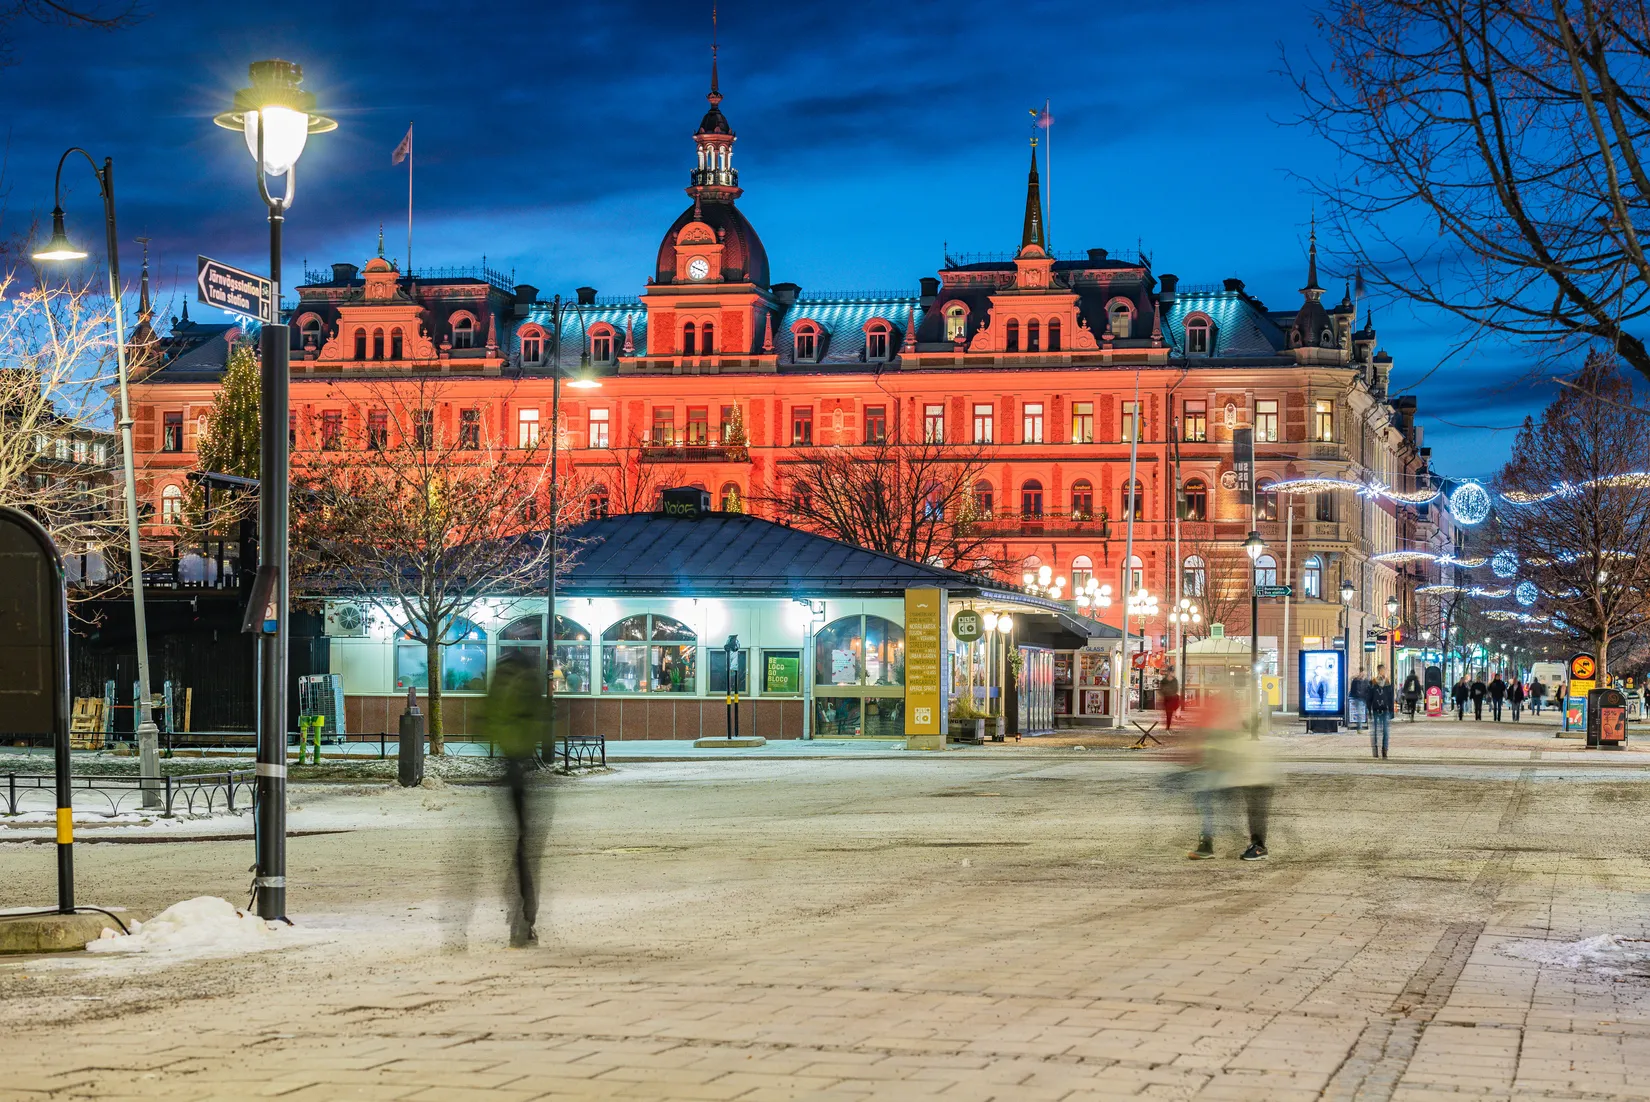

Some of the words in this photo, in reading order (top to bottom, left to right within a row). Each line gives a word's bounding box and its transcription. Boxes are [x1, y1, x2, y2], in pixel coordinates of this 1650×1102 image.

[209, 269, 259, 297] Järnvägsstation
[209, 284, 227, 302] Train
[227, 292, 250, 309] station
